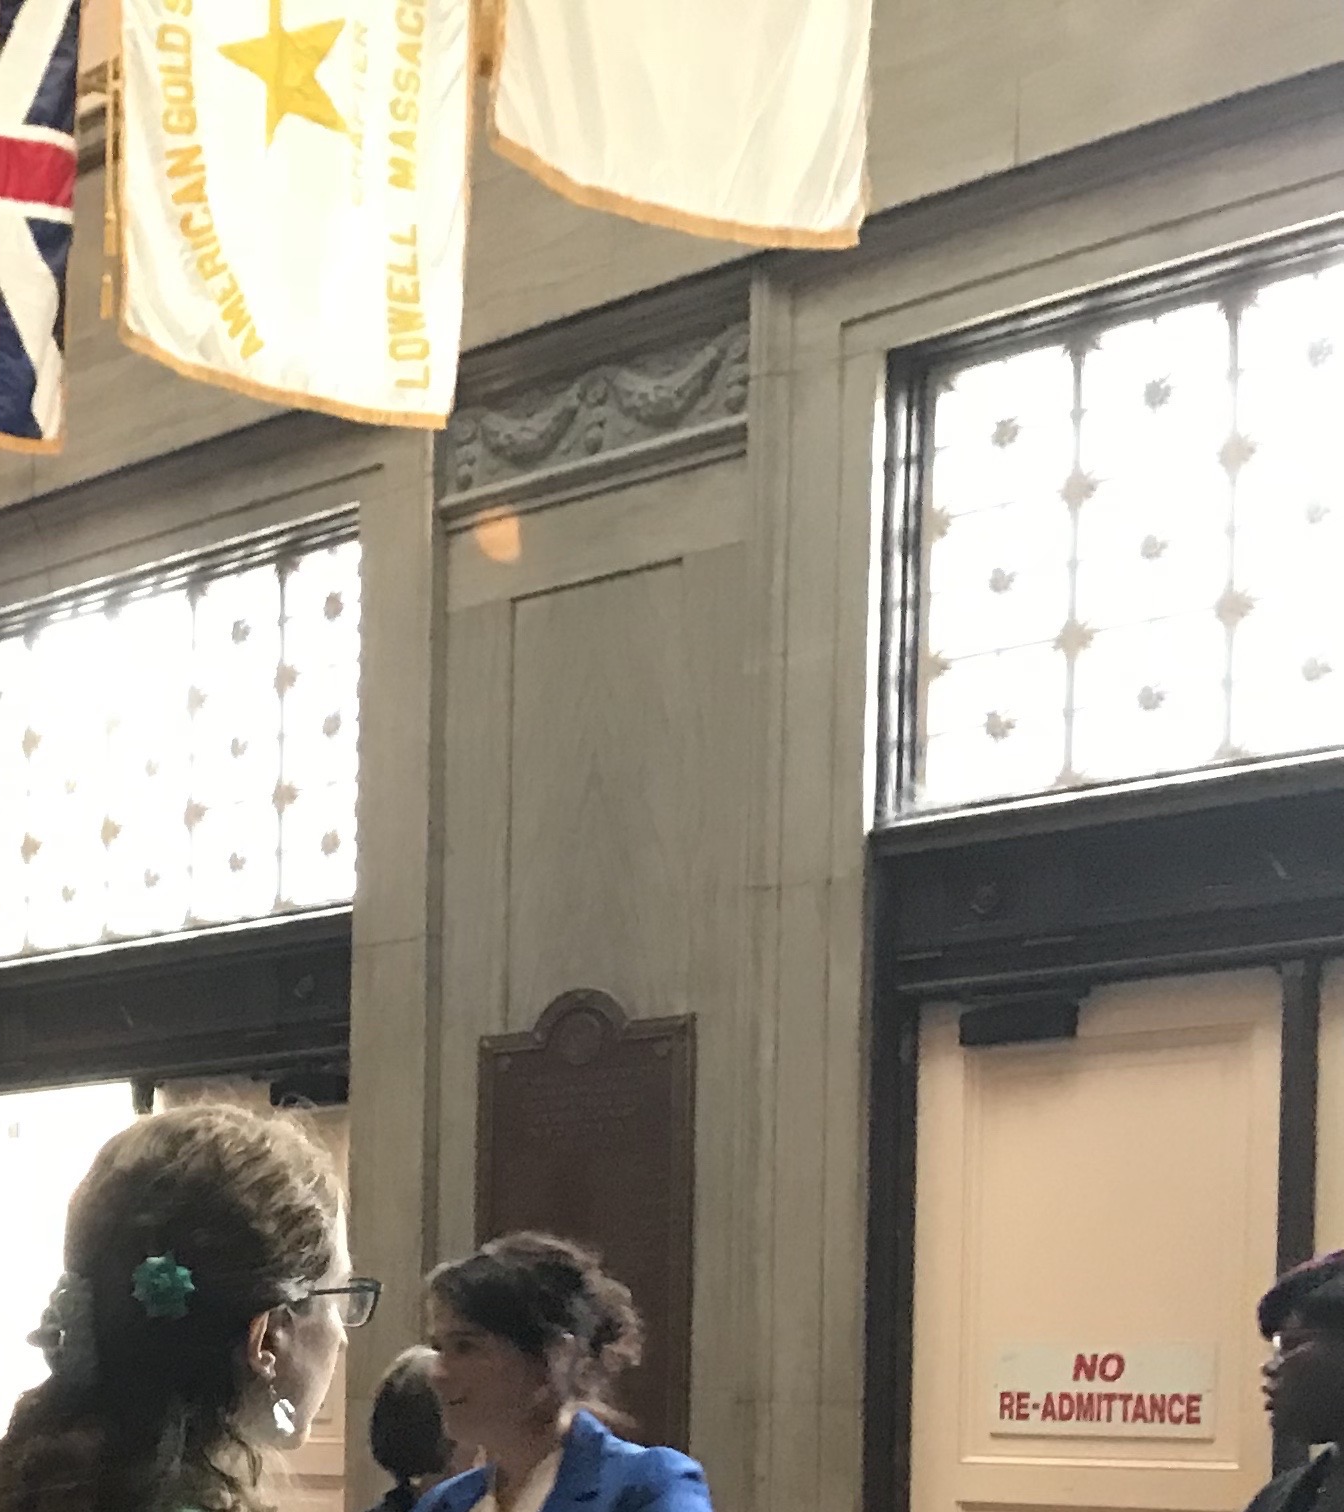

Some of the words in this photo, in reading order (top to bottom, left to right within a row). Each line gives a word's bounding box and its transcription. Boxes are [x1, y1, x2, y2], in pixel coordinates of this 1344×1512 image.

[154, 23, 199, 136] GOLD
[386, 0, 426, 191] MASSAC
[164, 144, 264, 360] AMERICAN
[386, 223, 430, 390] LOWELL
[999, 1391, 1202, 1425] RE-ADMITTANCE
[1073, 1353, 1125, 1382] NO
